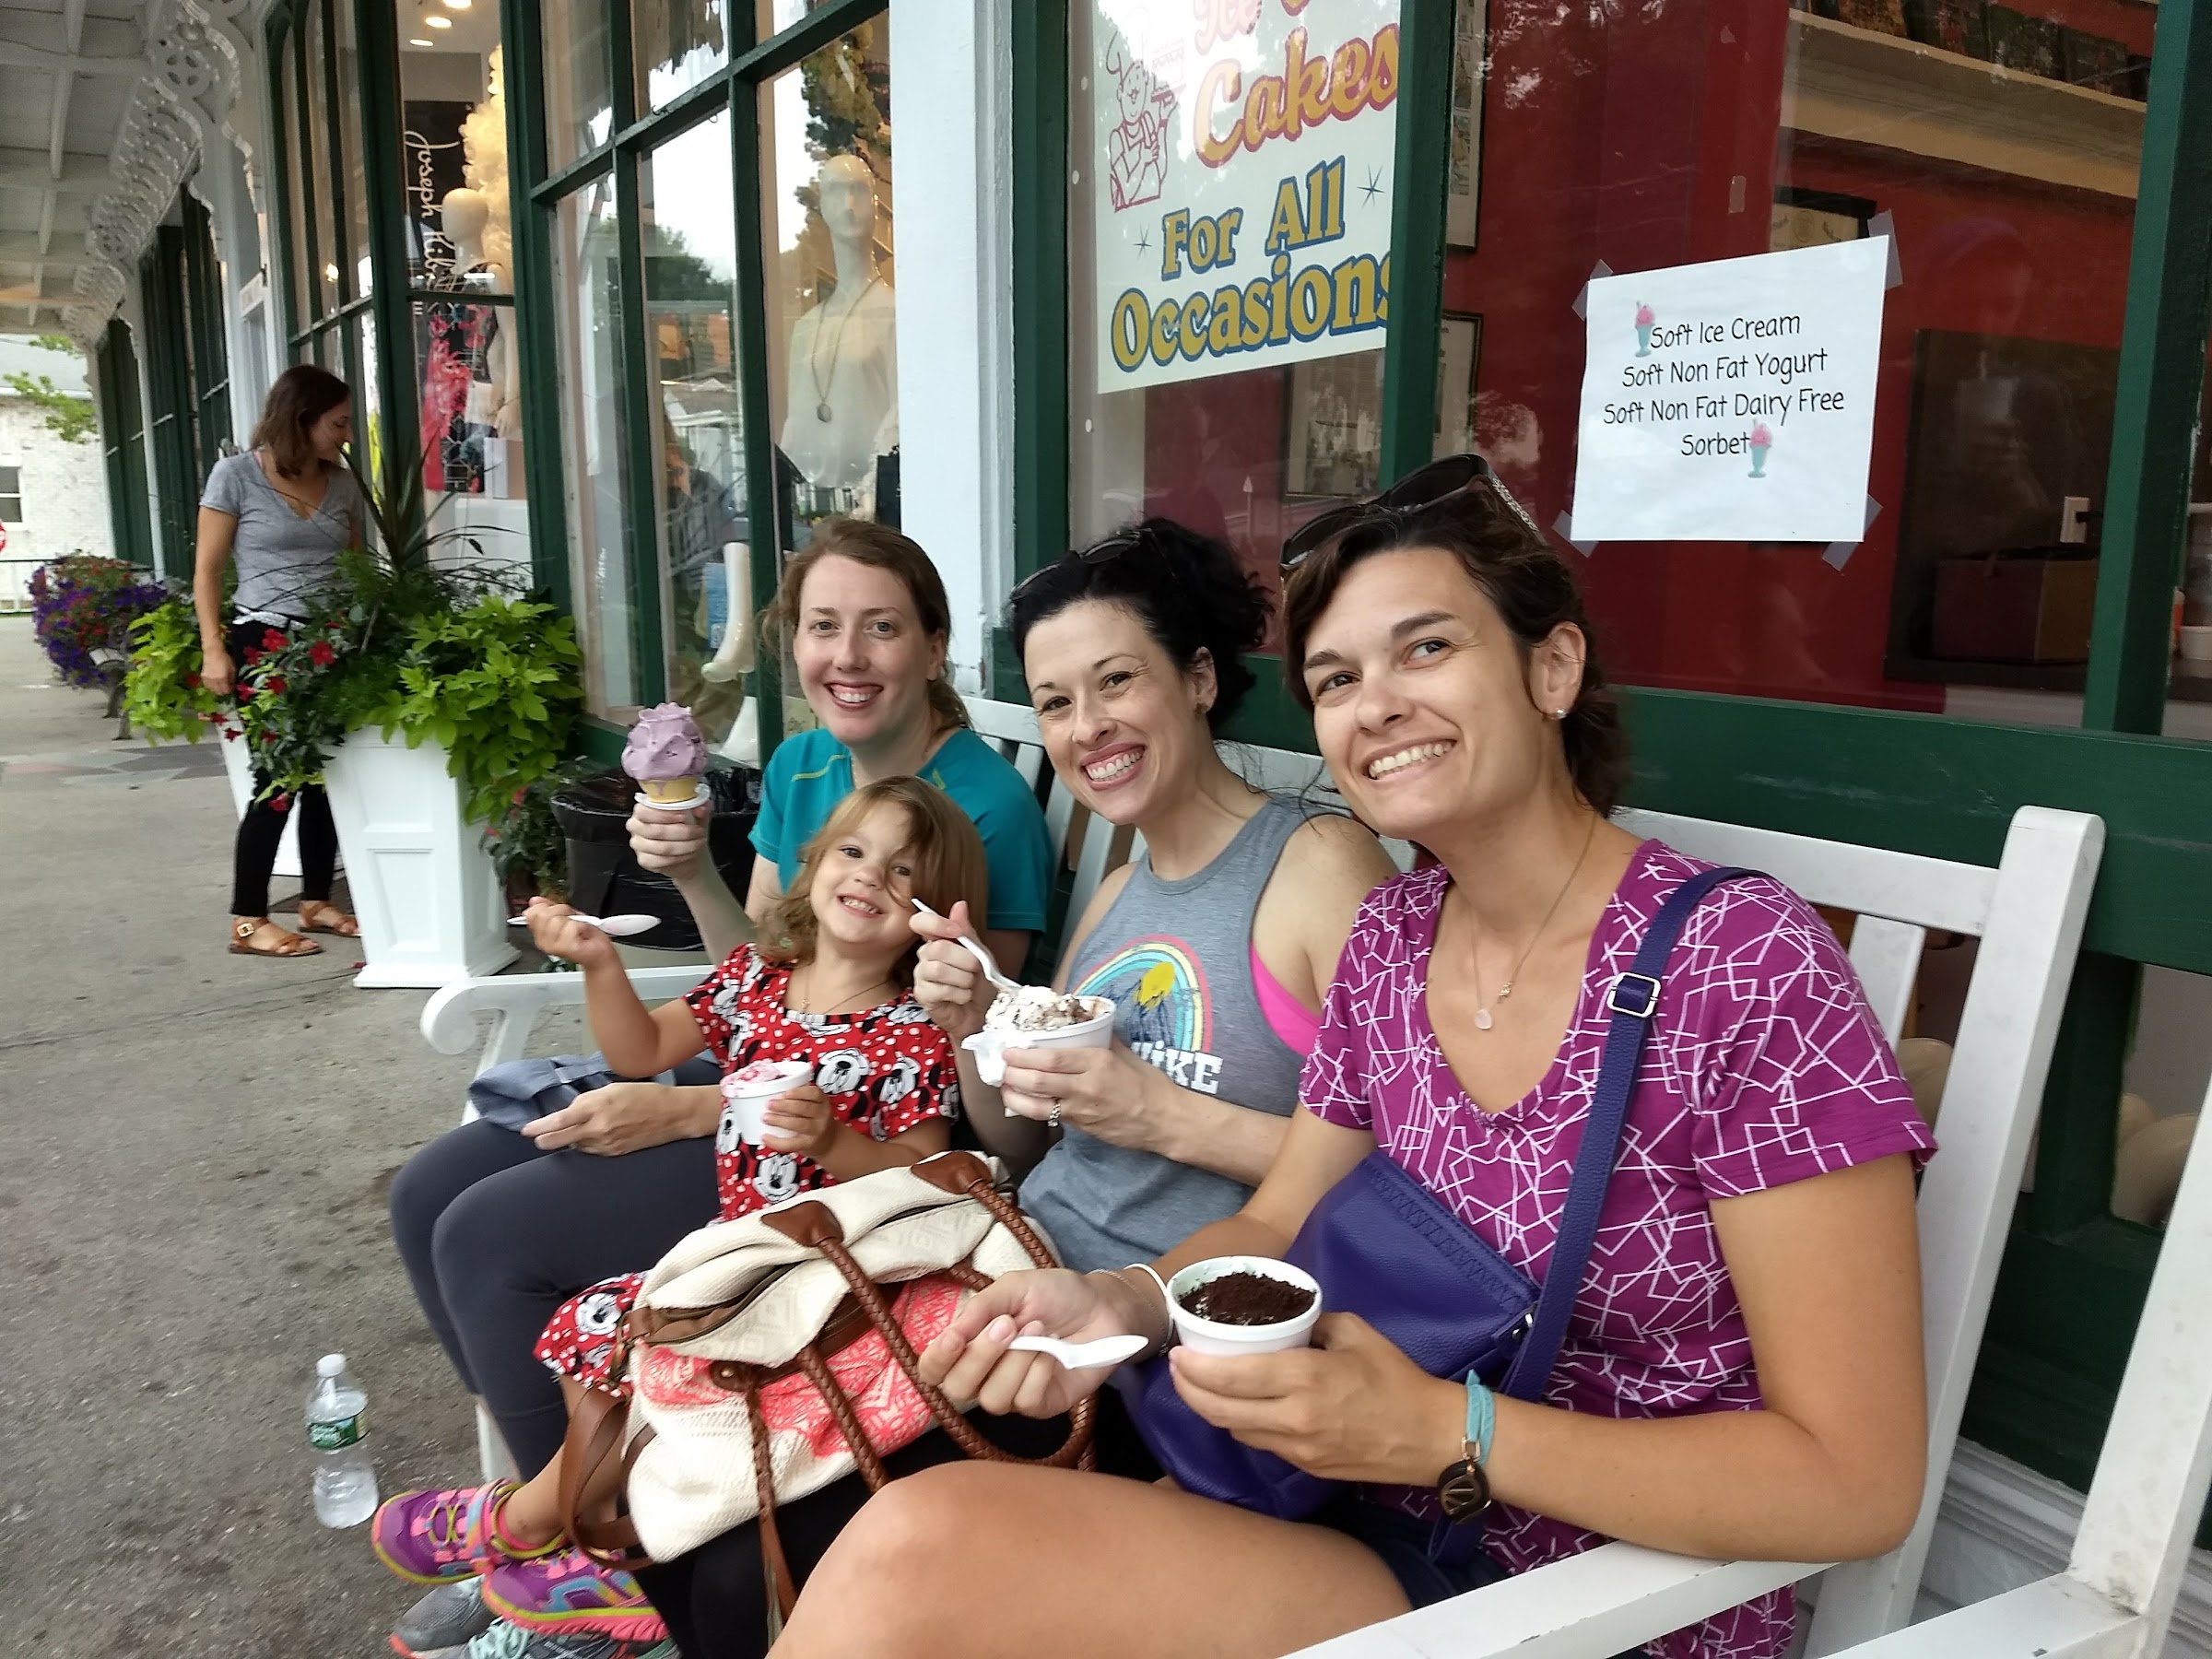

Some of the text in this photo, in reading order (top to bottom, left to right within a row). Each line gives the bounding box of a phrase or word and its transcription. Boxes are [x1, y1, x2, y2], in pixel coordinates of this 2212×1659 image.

[1193, 23, 1399, 168] Cakes
[405, 130, 460, 218] Joseph
[1161, 155, 1346, 281] For All
[1650, 315, 1800, 348] Soft Ice Cream
[1622, 347, 1829, 387] Soft Non Fat Yogurt
[1604, 388, 1844, 427] Soft Non Fat Dairy Free
[1681, 431, 1751, 456] Sorbet
